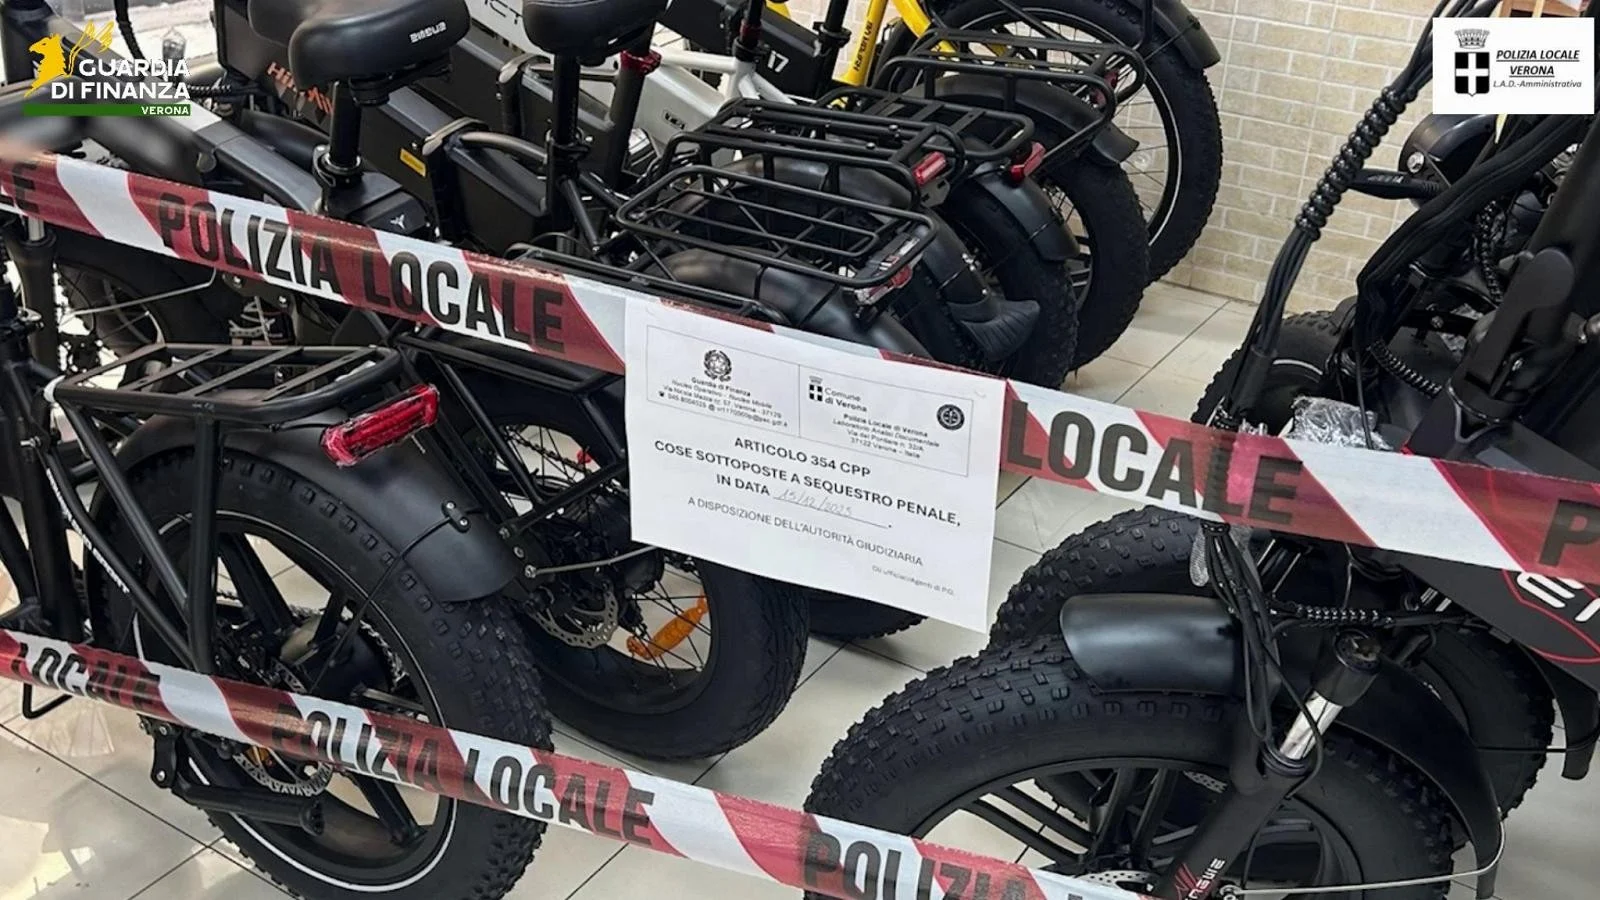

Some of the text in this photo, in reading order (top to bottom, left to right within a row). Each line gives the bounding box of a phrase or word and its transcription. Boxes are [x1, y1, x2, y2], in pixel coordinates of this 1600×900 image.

[157, 192, 563, 353] POLIZIA LOCALE
[825, 387, 861, 402] Comune
[825, 396, 867, 412] di Verona
[654, 440, 961, 527] COSE SOTTOPOSTE A SEQUESTRO PENALE,
[734, 437, 871, 477] ARTICOLO 354 CPP
[1005, 402, 1303, 525] LOCALE
[716, 474, 770, 496] IN DATA
[687, 497, 696, 507] A
[698, 498, 772, 526] DISPOSIZIONE
[856, 539, 924, 566] GIUDIZIARIA
[273, 703, 655, 848] POLIZIA LOCALE
[1187, 858, 1226, 900] NGWE
